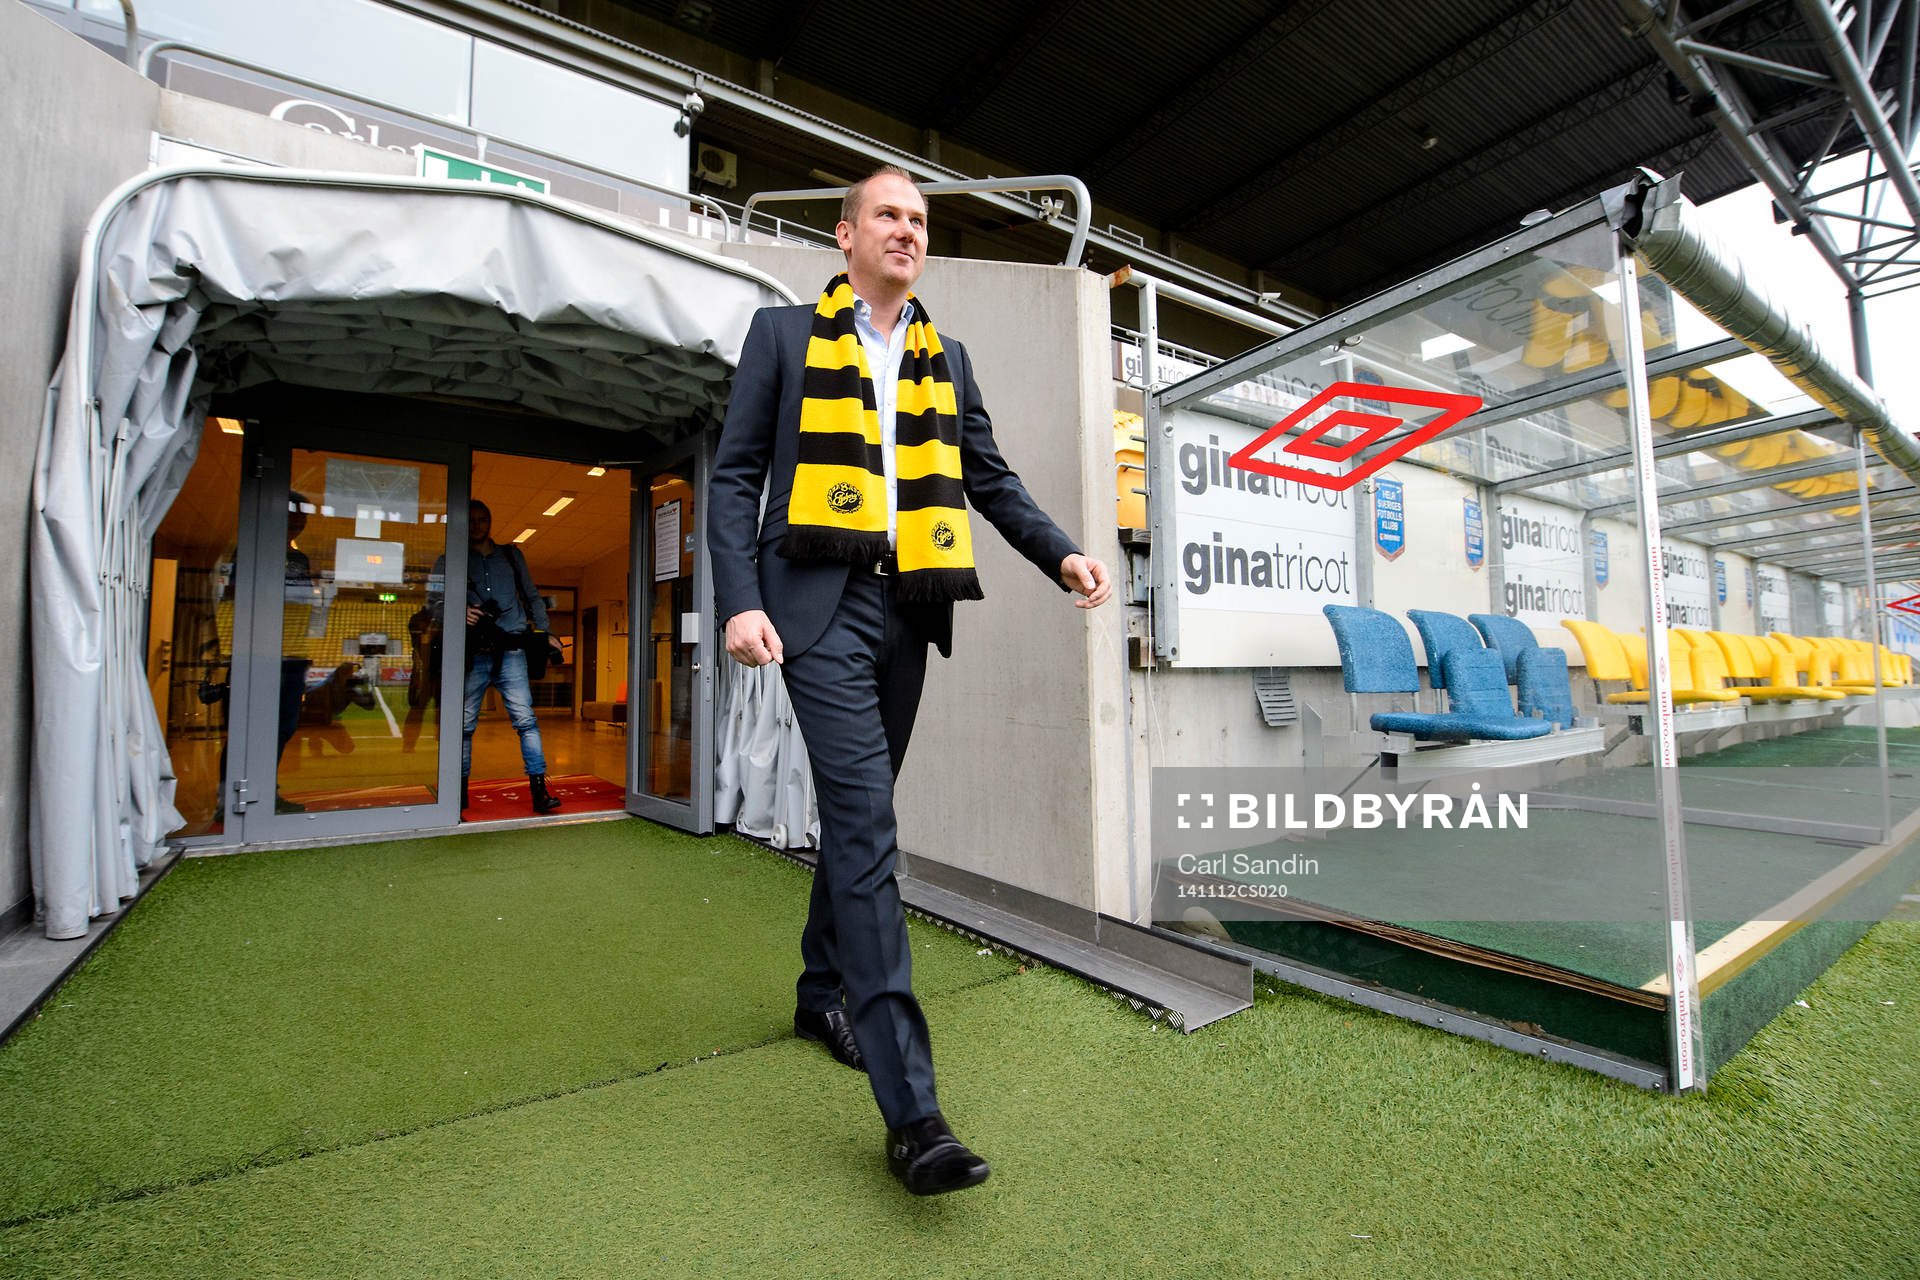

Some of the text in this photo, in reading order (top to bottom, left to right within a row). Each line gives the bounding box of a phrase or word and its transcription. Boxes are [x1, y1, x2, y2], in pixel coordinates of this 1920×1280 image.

[1182, 531, 1350, 595] ginatricot
[1651, 546, 1661, 623] umbro.com
[1661, 691, 1671, 769] umbro.com
[1669, 840, 1679, 920] umbro.com
[1679, 990, 1689, 1071] umbro.com
